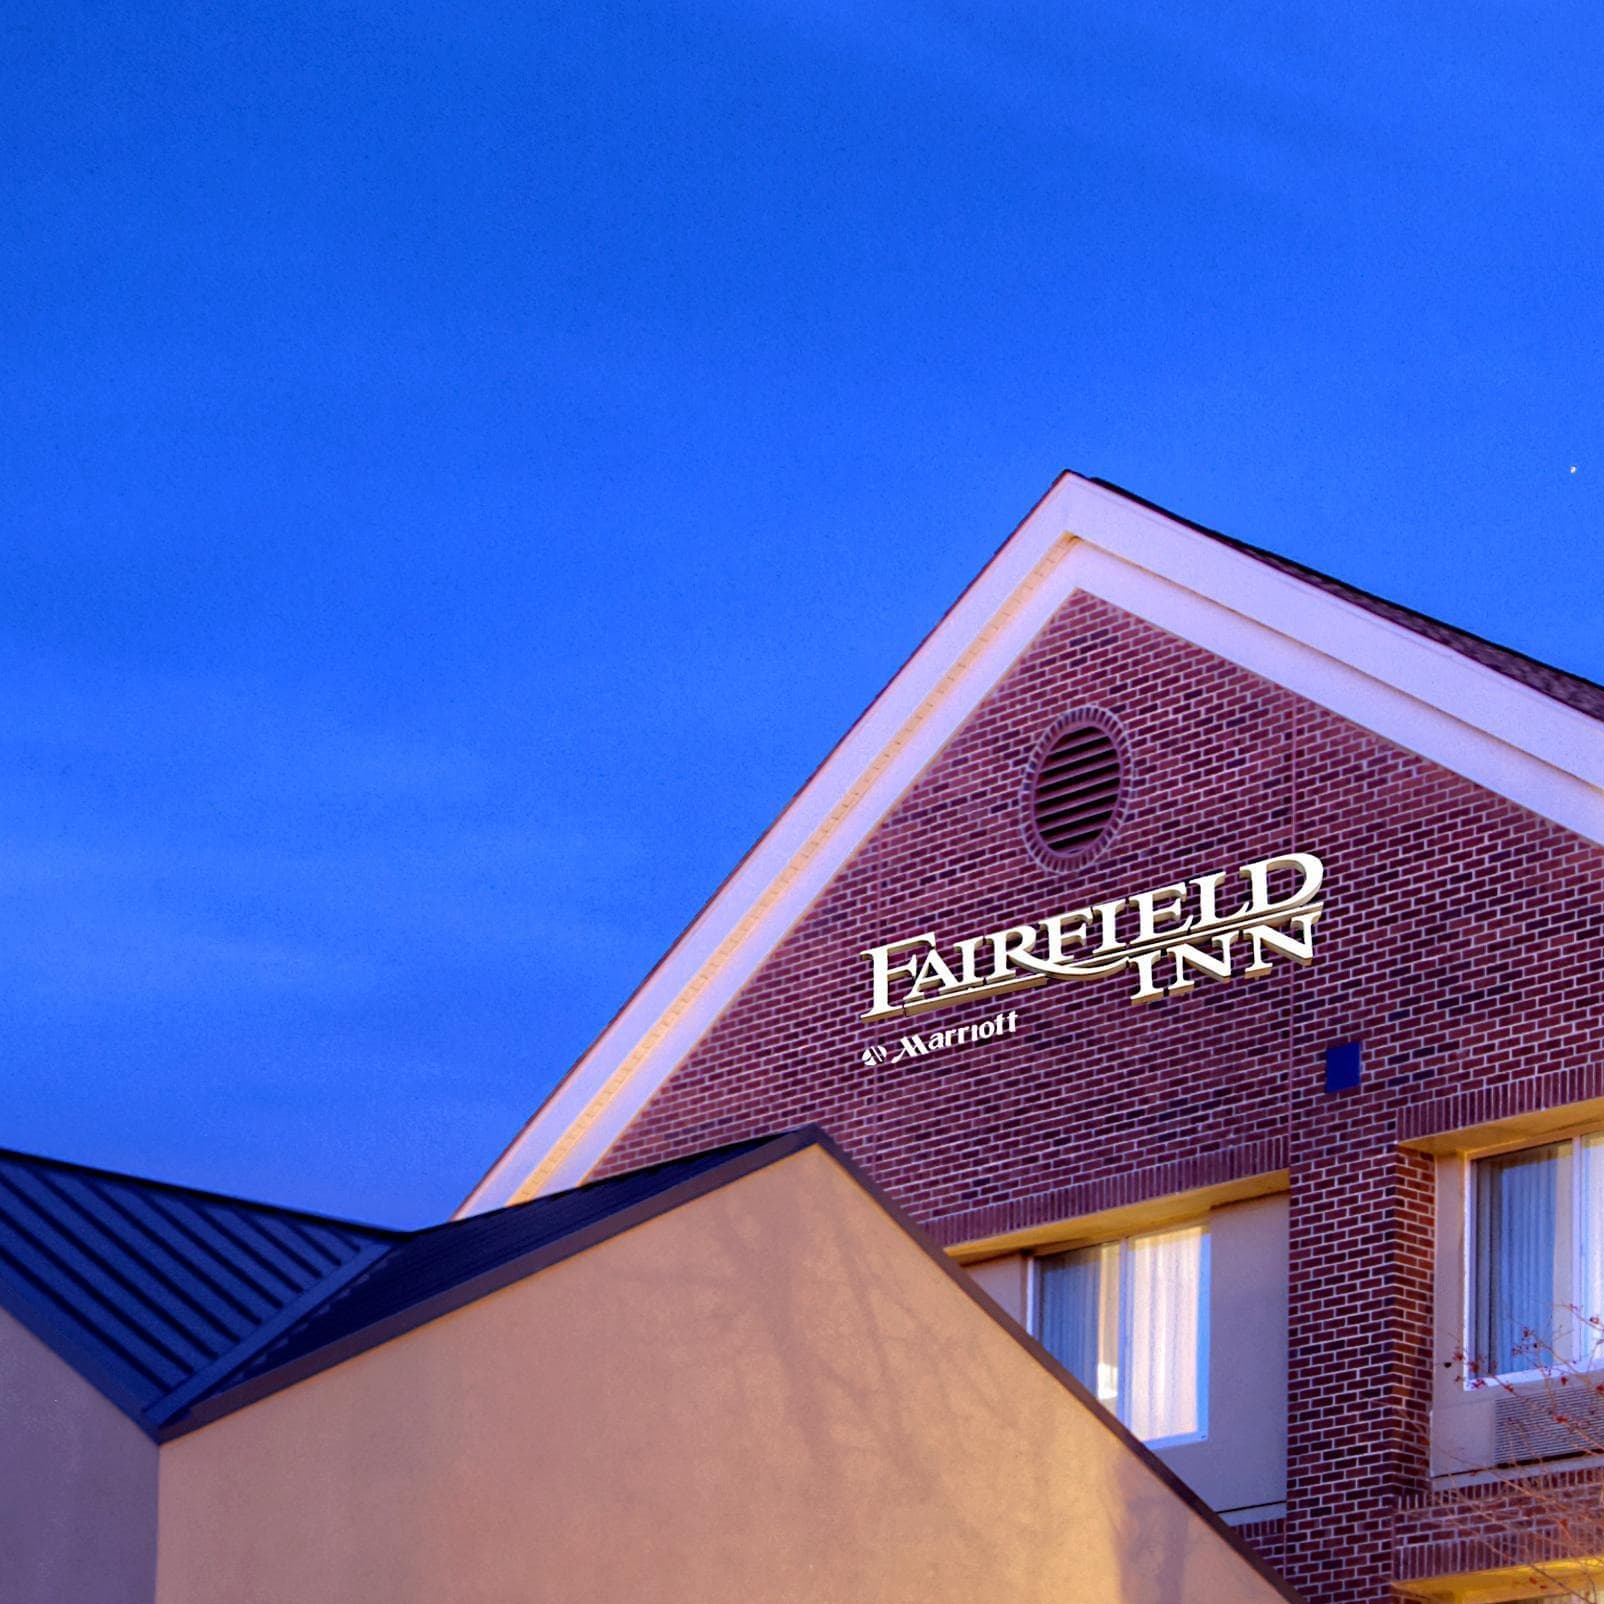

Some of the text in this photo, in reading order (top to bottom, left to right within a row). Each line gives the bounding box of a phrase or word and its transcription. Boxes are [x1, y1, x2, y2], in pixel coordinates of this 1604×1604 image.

[860, 852, 1325, 1021] FAIRFIELD
[1130, 910, 1323, 1004] INN
[890, 1010, 1018, 1064] Marriott
